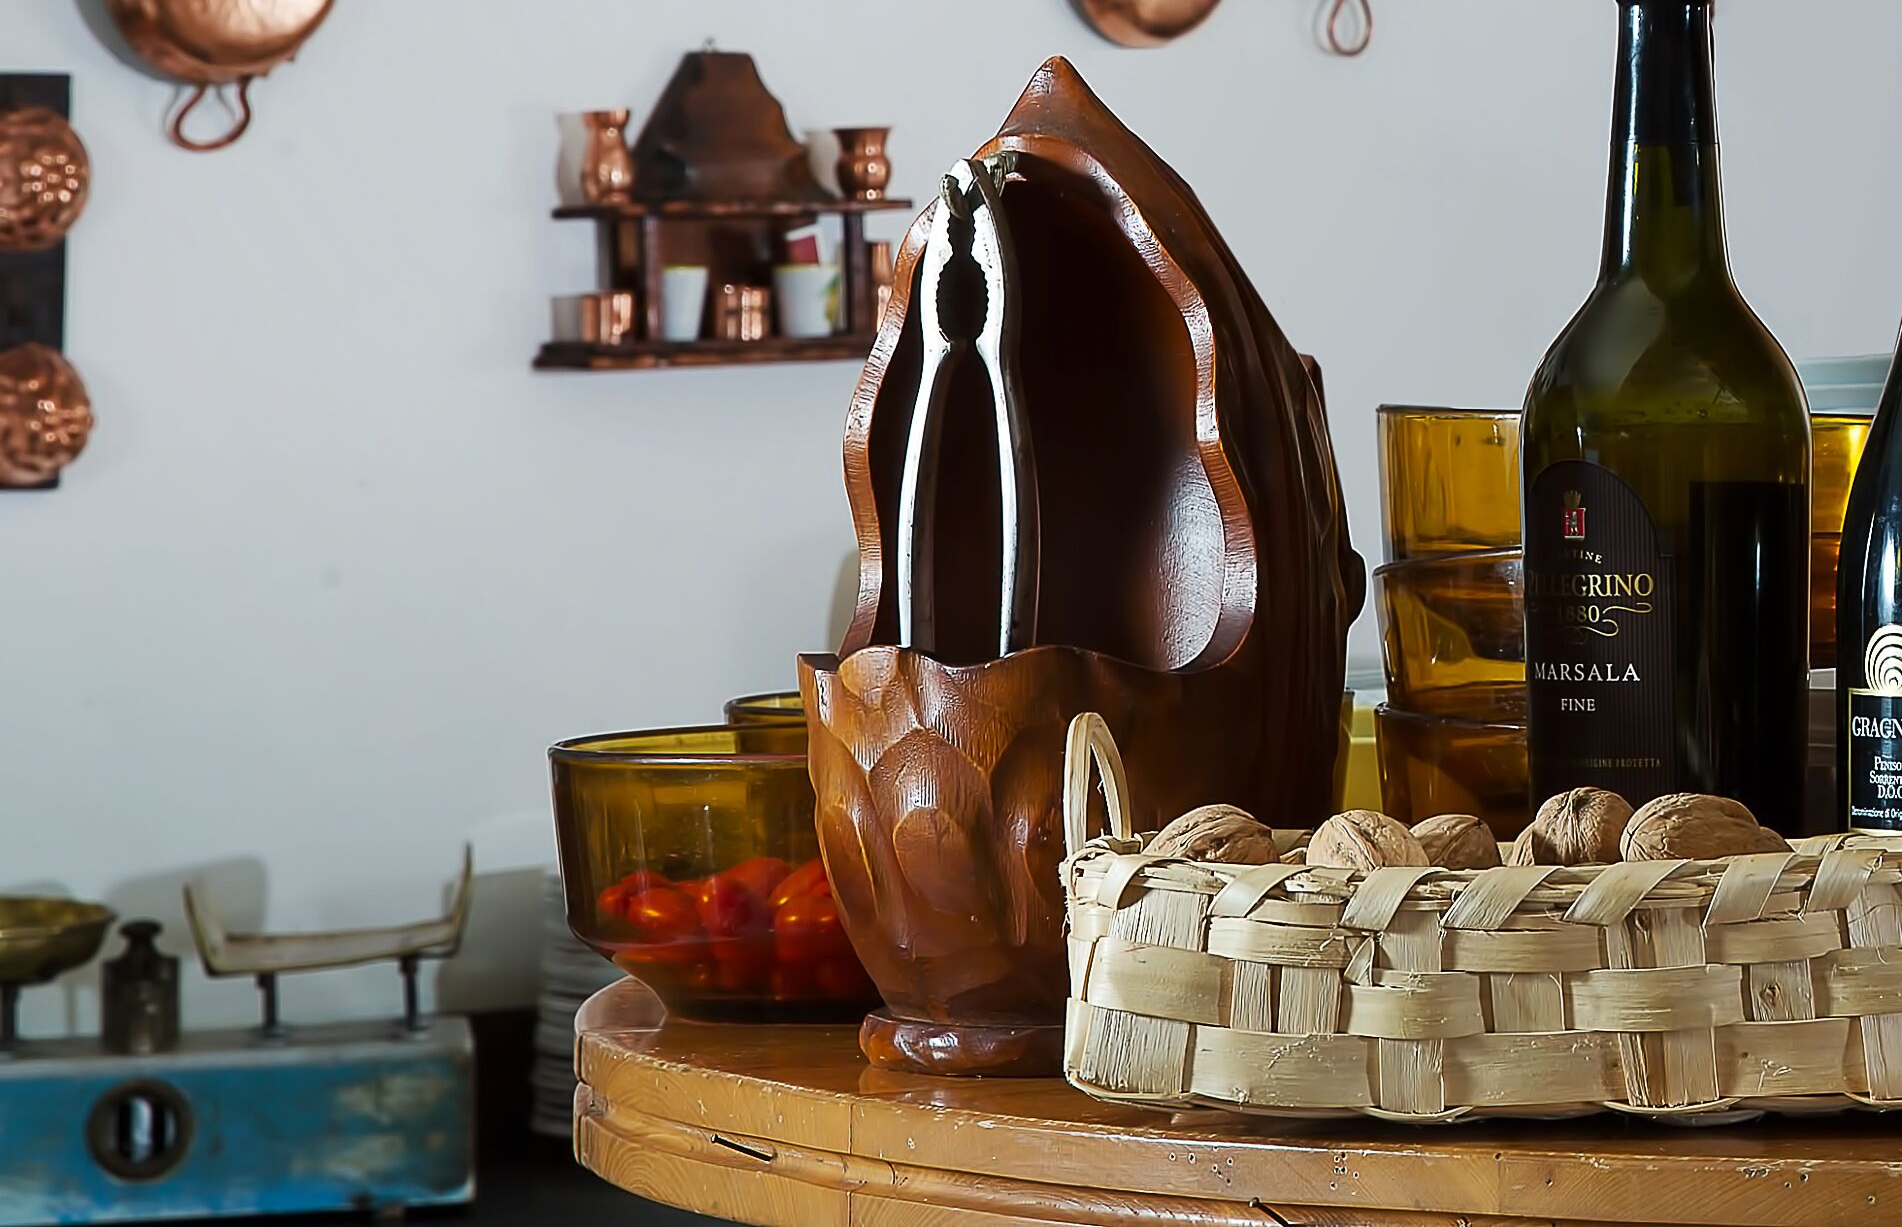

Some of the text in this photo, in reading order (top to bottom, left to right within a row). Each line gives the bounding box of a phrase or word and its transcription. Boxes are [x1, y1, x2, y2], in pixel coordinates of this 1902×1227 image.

[1559, 604, 1601, 623] 1880
[1534, 662, 1641, 683] MARSALA
[1560, 698, 1597, 712] FINE
